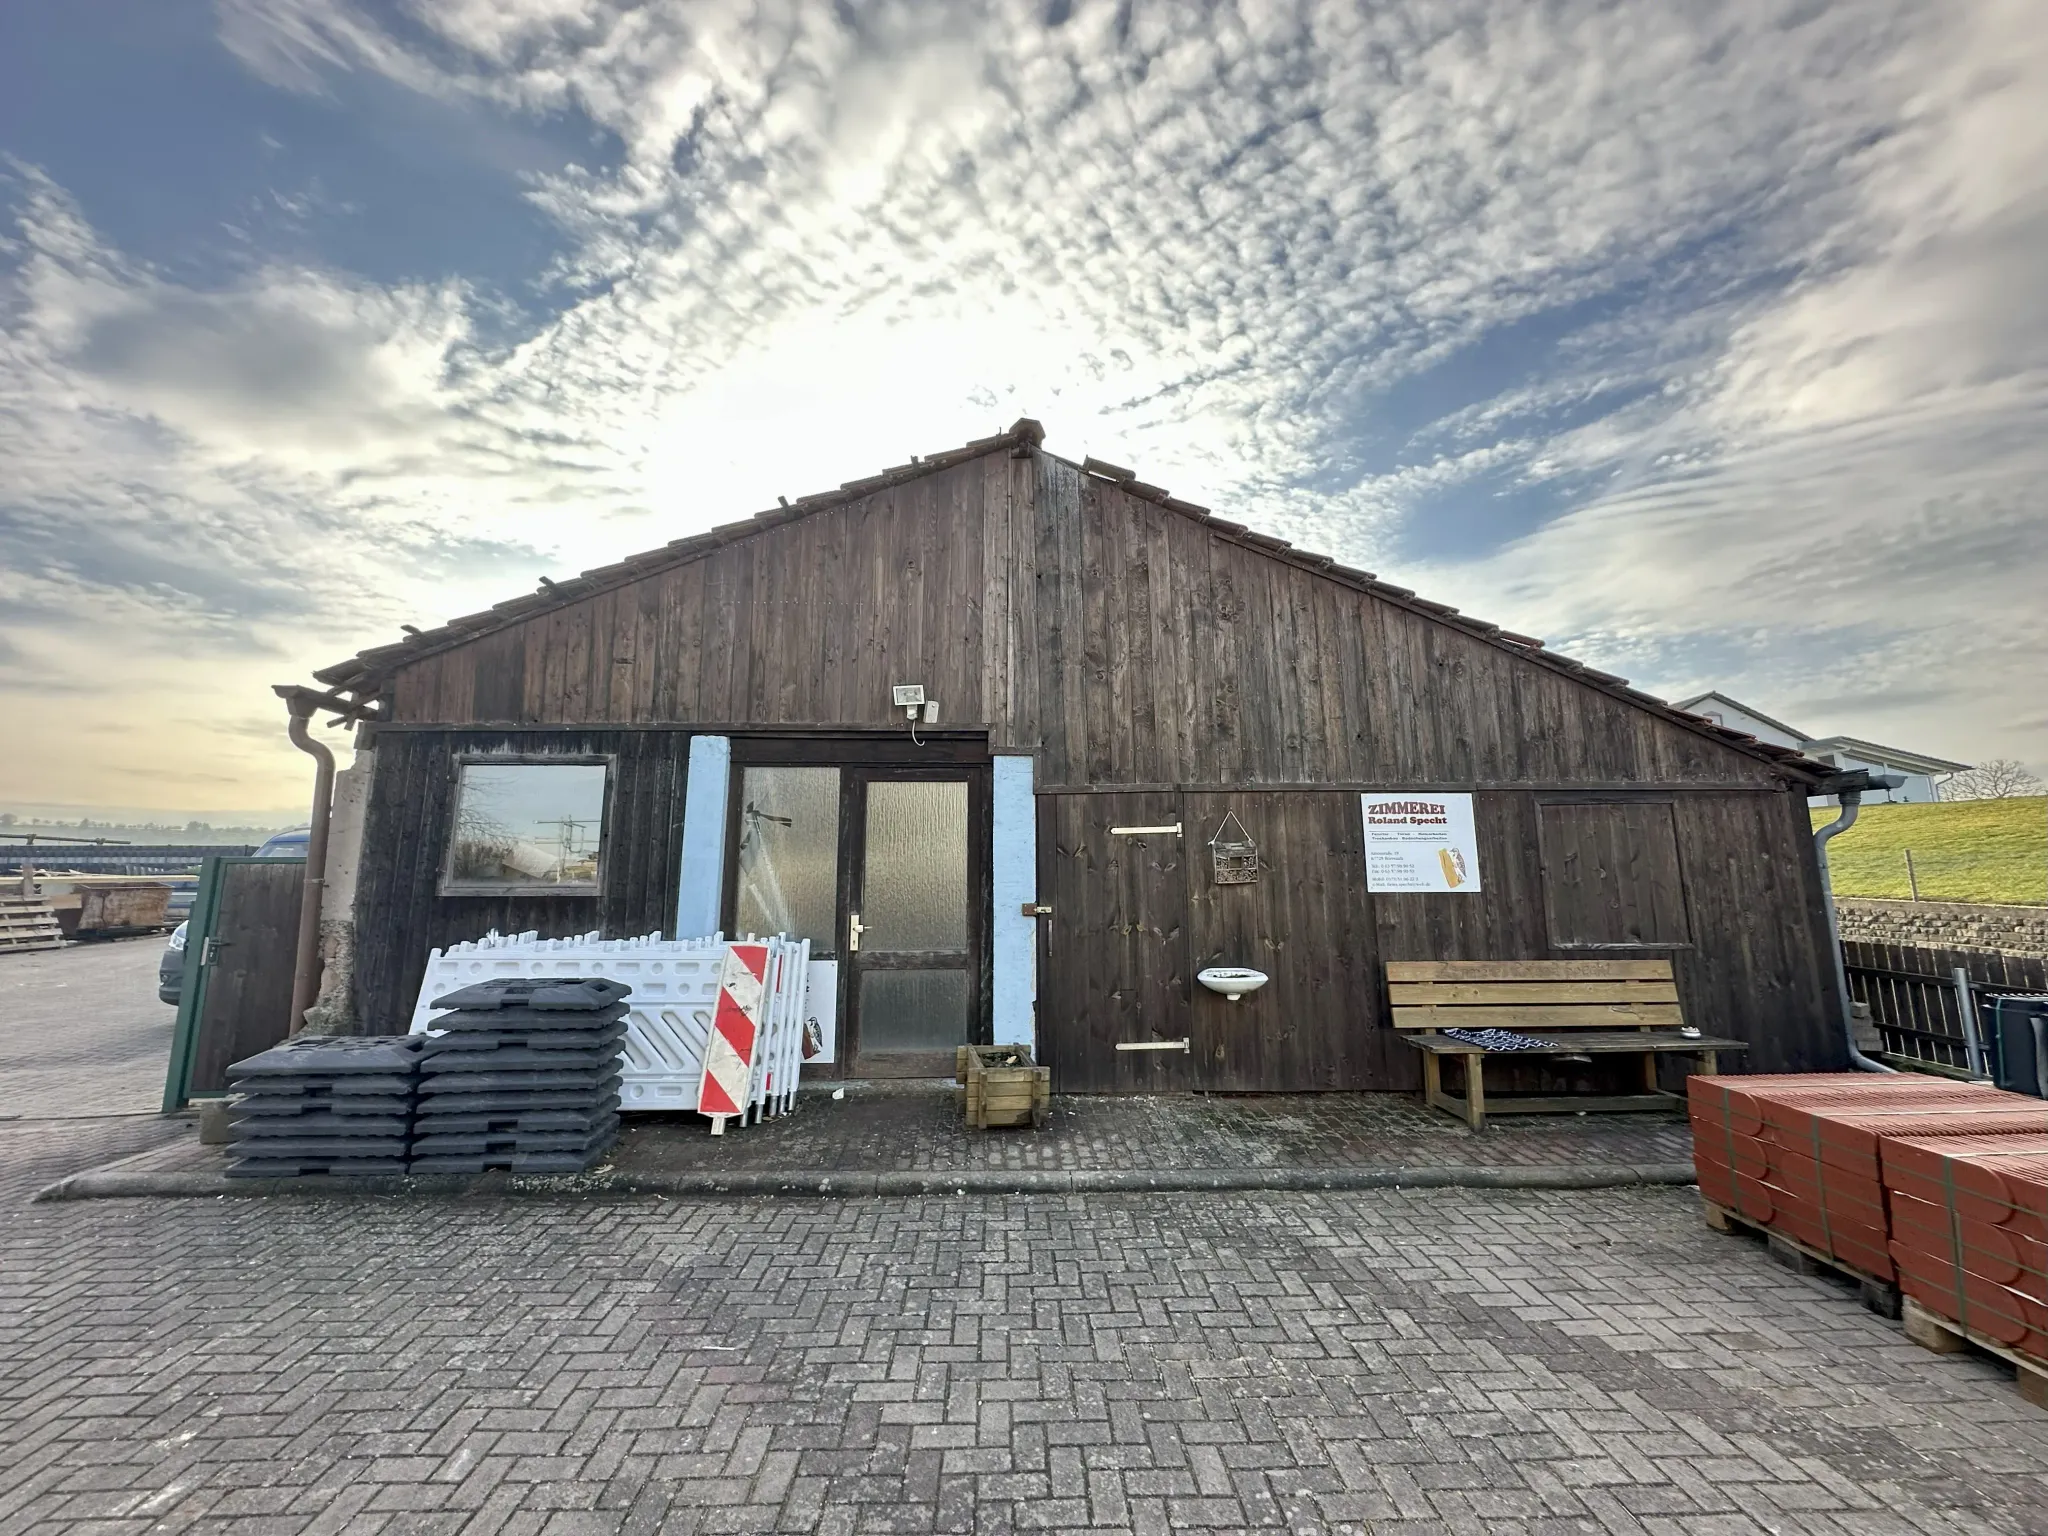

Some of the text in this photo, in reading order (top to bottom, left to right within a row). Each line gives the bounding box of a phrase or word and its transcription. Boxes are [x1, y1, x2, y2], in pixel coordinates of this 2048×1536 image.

[1367, 801, 1446, 815] ZIMMEREI
[1368, 816, 1448, 825] Roland Specht
